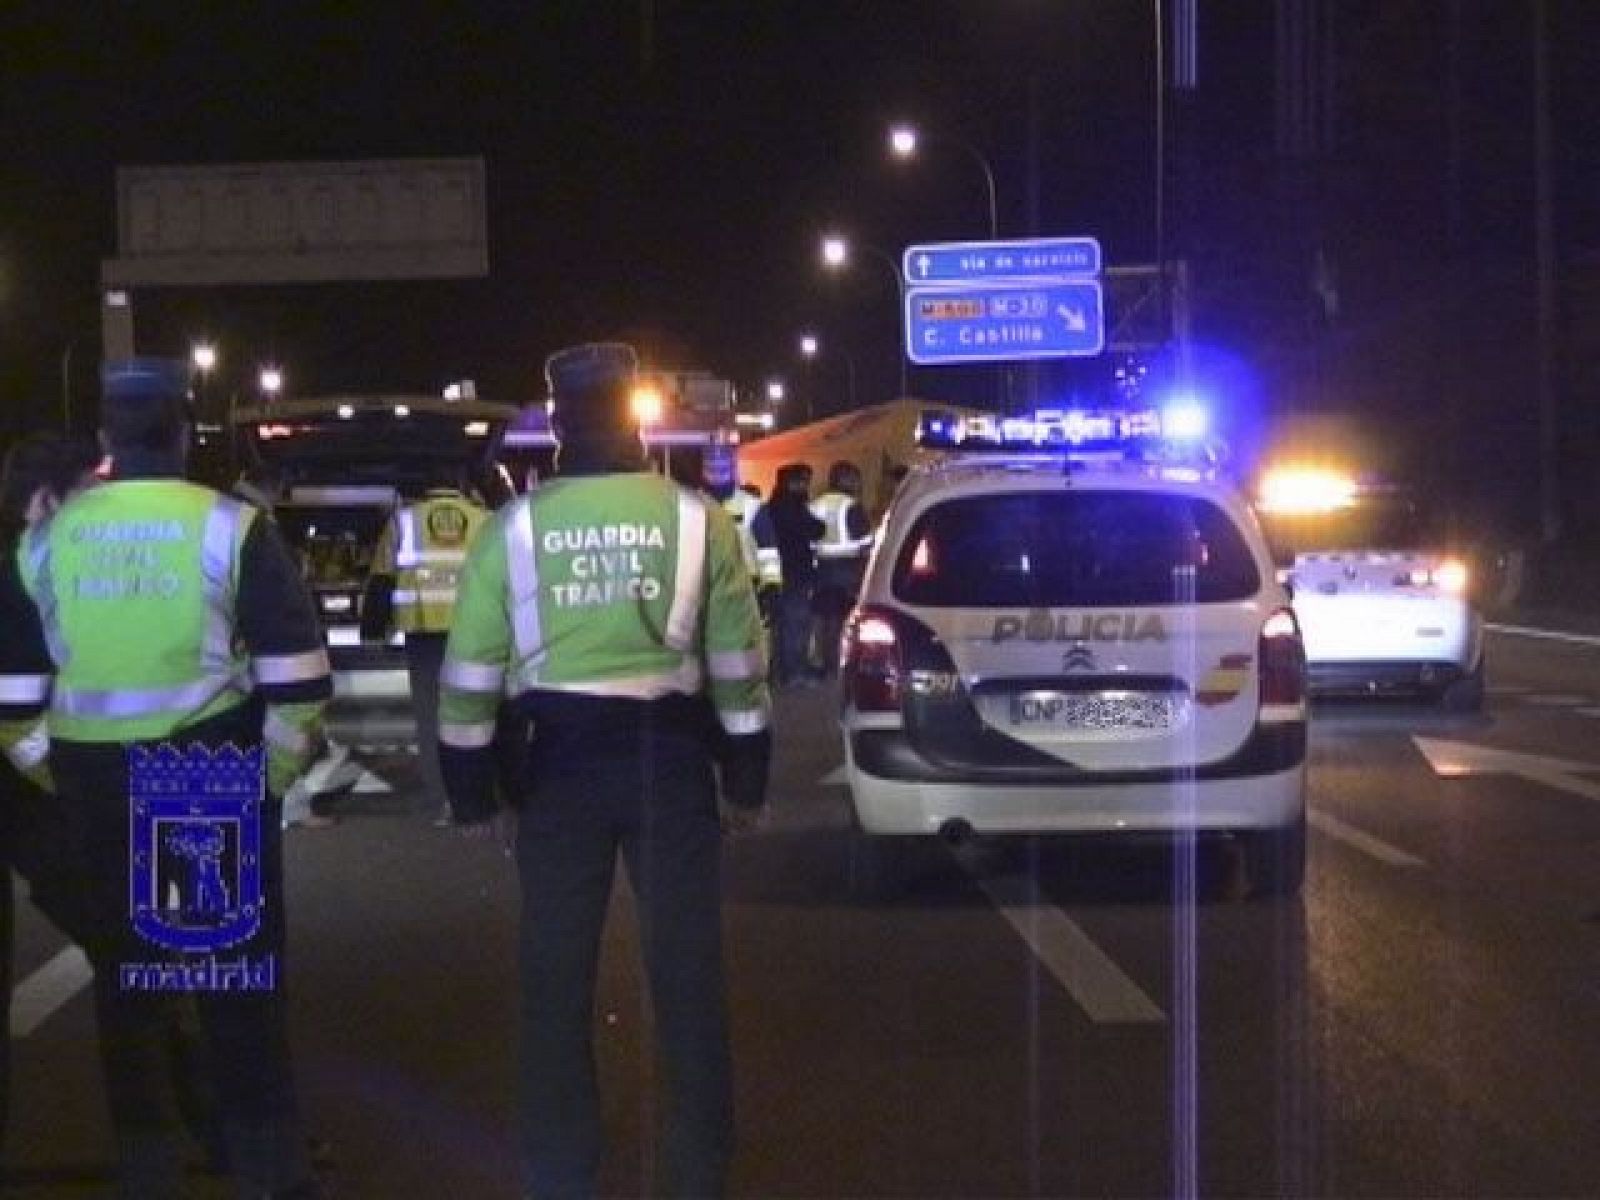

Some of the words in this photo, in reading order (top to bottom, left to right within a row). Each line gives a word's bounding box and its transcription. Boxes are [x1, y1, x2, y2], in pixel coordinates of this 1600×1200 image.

[543, 523, 664, 552] GUARDIA
[571, 550, 643, 578] CIVIL
[993, 612, 1166, 643] POLICIA
